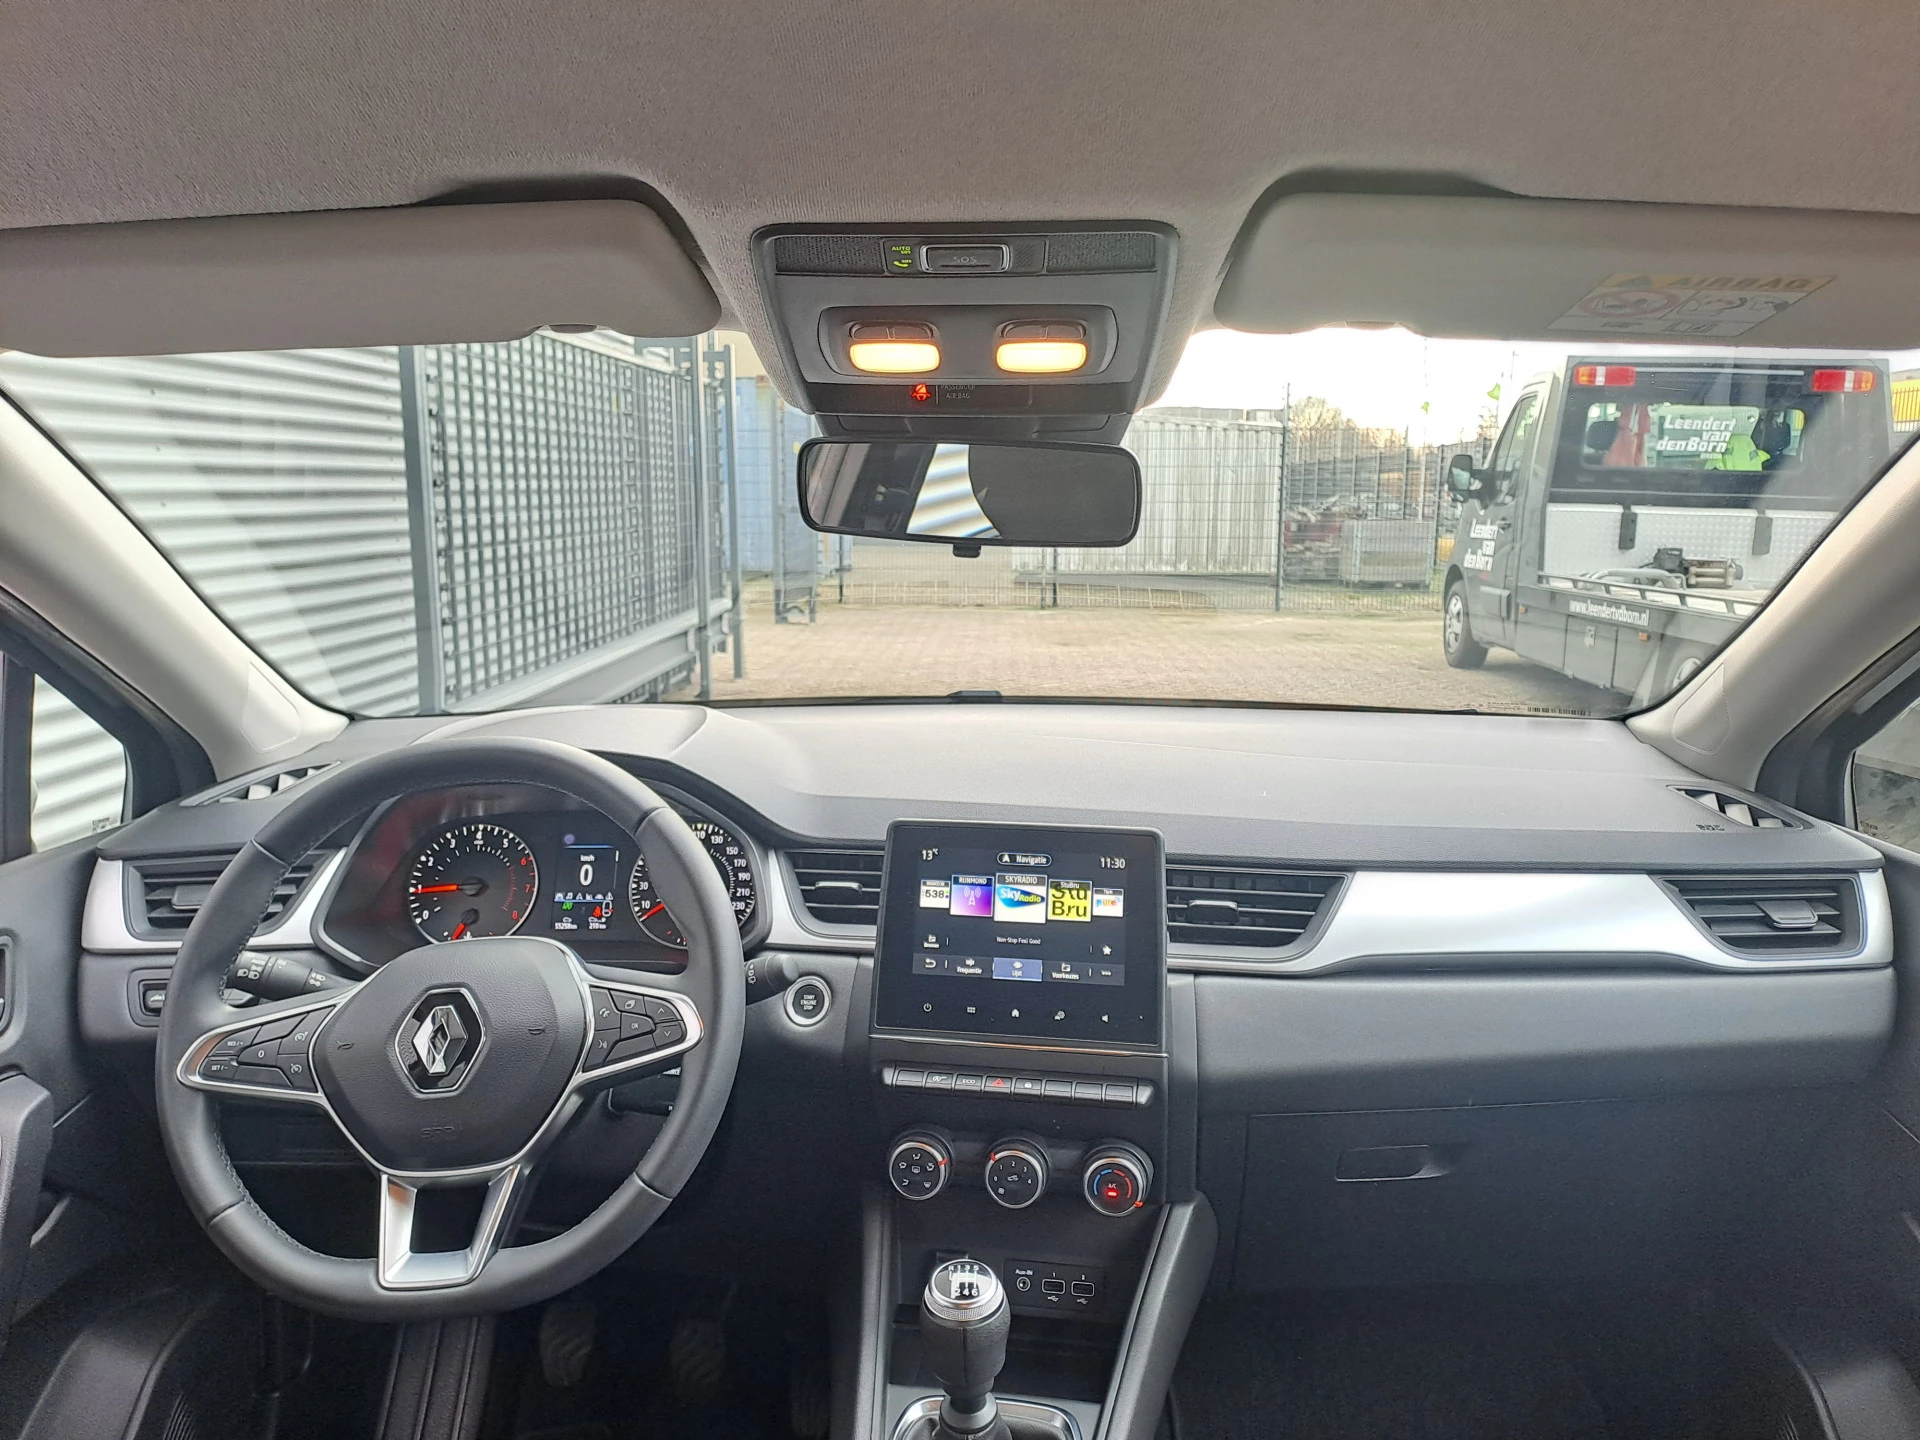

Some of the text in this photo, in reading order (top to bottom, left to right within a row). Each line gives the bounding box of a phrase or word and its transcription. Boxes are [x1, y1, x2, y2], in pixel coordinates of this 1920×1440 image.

[1669, 276, 1811, 290] AIRBAG
[1663, 414, 1736, 431] Leendert
[1702, 430, 1732, 442] van
[476, 831, 482, 840] 4
[710, 836, 724, 844] 130
[450, 839, 456, 848] 3
[502, 838, 508, 848] 5
[726, 846, 738, 855] 150
[428, 856, 434, 866] 2
[520, 858, 526, 866] 6
[734, 858, 746, 868] 170
[1016, 855, 1047, 865] Navigatie
[1100, 856, 1126, 868] 11:30
[580, 864, 593, 886] 0
[738, 872, 750, 881] 190
[1005, 876, 1038, 884] SKYRADIO
[525, 884, 530, 892] 7
[638, 882, 648, 890] 30
[736, 888, 750, 896] 210
[925, 889, 944, 898] 538
[1000, 887, 1020, 901] Sky
[1018, 894, 1041, 903] Radio
[641, 900, 650, 909] 10
[1052, 901, 1088, 917] Bru
[422, 910, 429, 920] 0
[512, 911, 518, 919] 8
[956, 966, 982, 974] Frequentie
[962, 1288, 970, 1296] 4
[972, 1288, 978, 1296] 6
